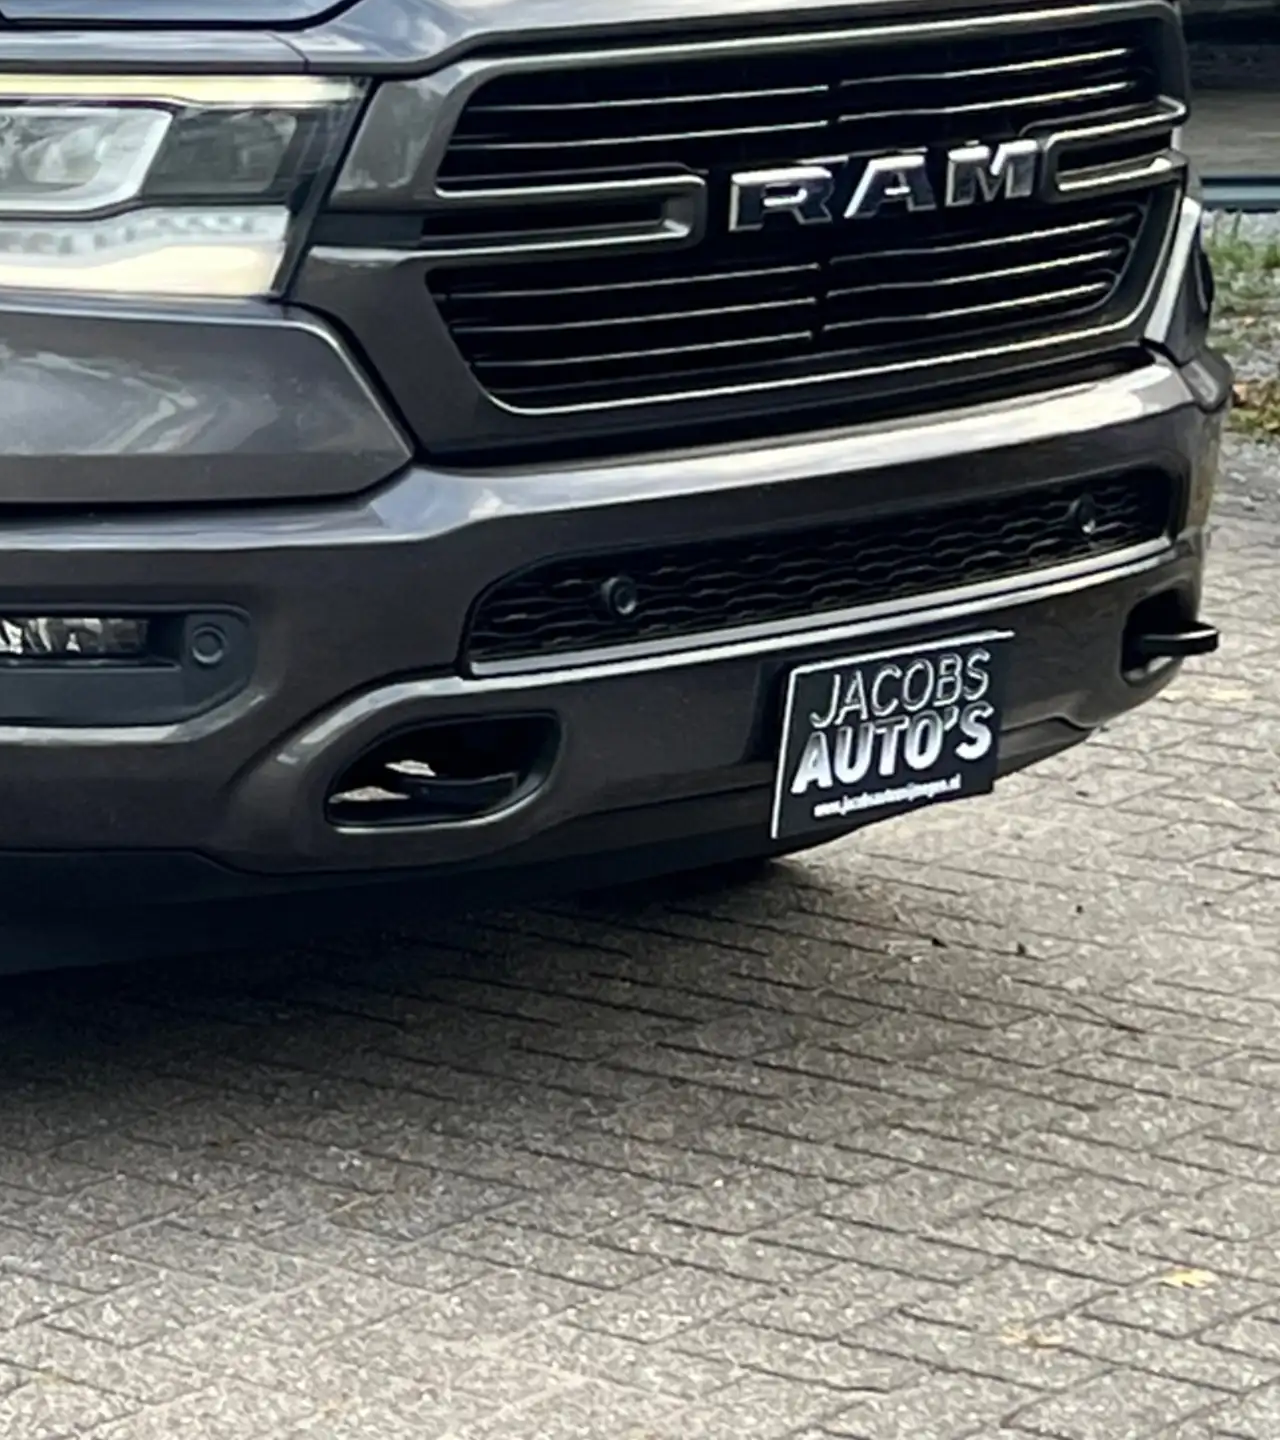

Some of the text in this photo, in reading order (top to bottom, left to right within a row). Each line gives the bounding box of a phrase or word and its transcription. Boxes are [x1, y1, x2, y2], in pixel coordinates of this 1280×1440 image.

[729, 139, 1039, 232] RAM
[809, 647, 991, 728] JACOBS
[791, 700, 995, 793] AUTO'S
